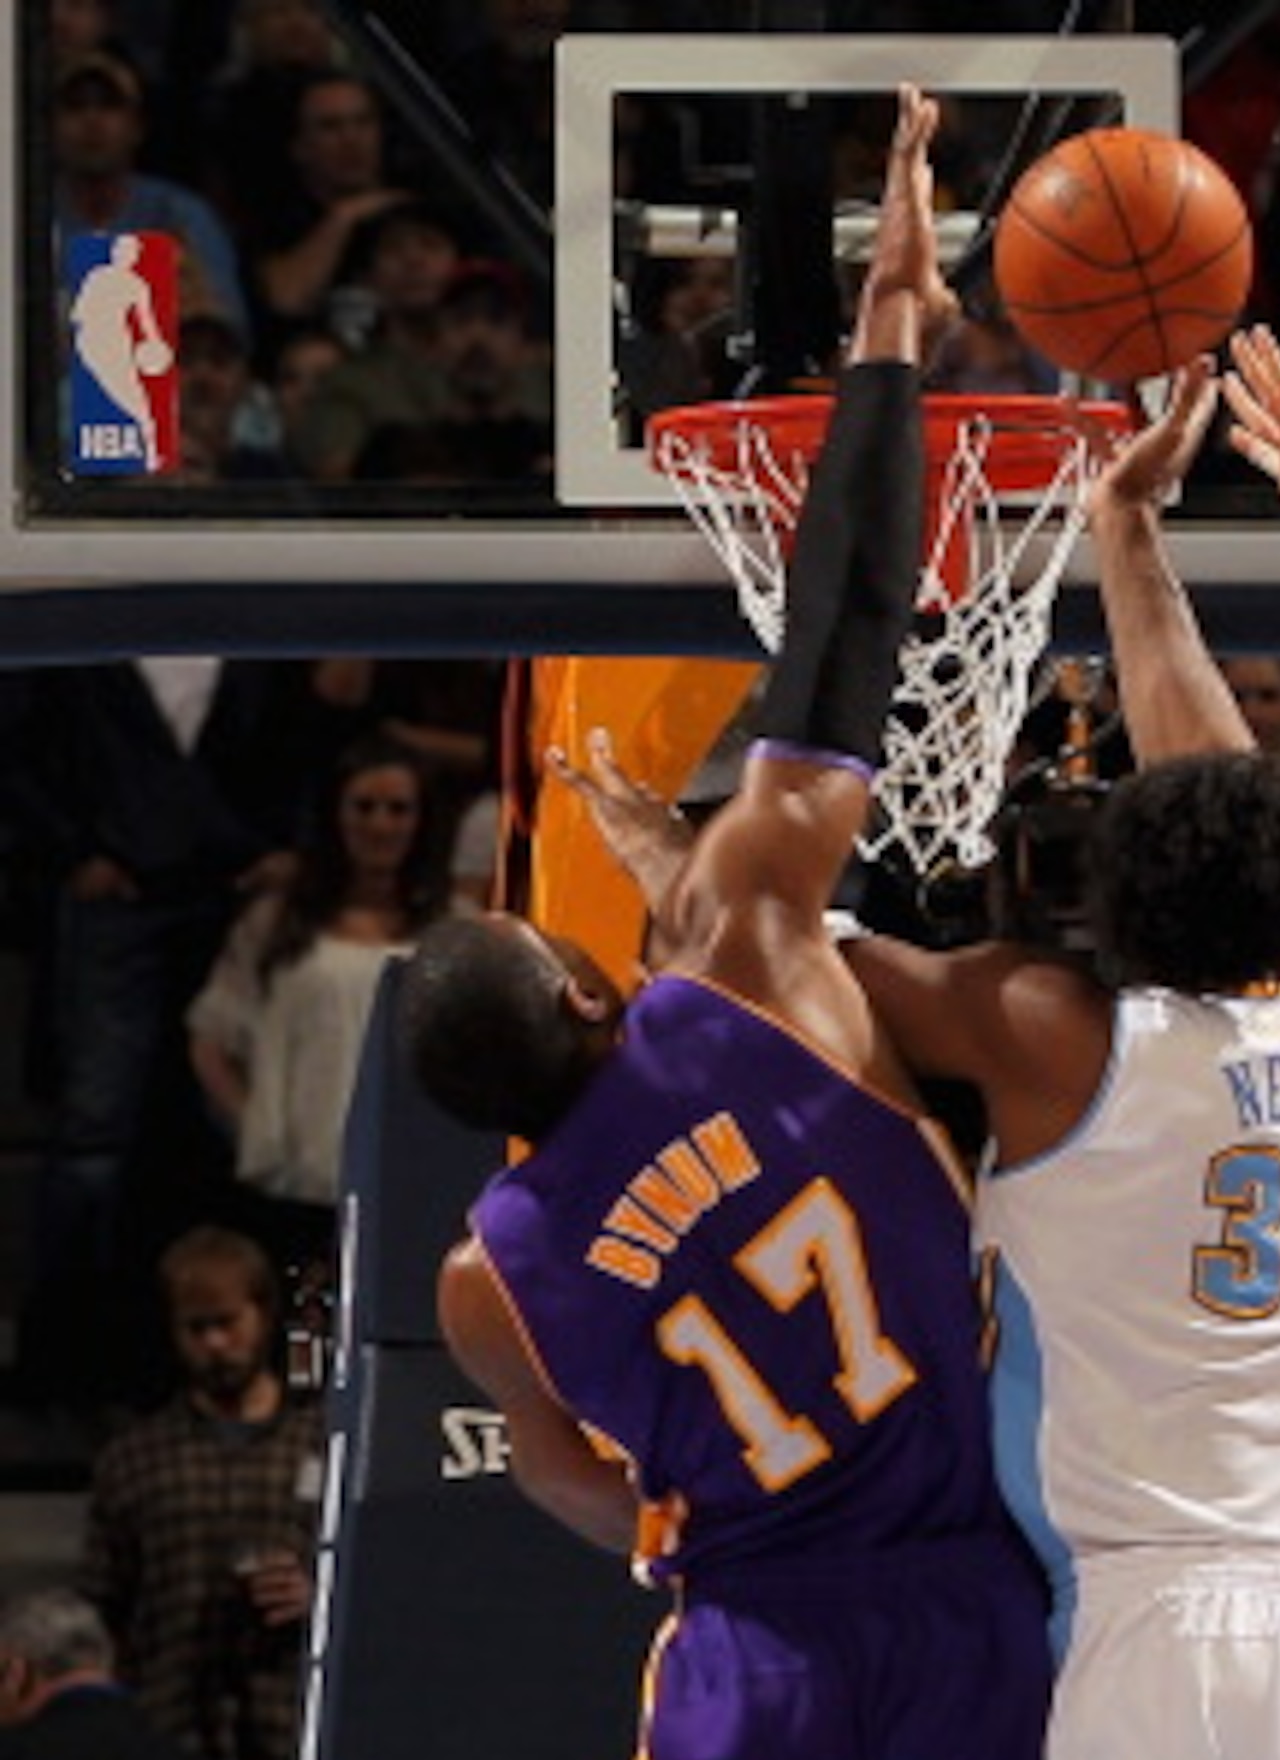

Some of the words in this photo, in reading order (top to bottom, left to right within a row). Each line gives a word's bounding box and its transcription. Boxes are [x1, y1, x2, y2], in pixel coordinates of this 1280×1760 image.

[80, 424, 144, 460] NBA
[585, 1111, 764, 1290] BYNUM
[656, 1176, 916, 1495] 17
